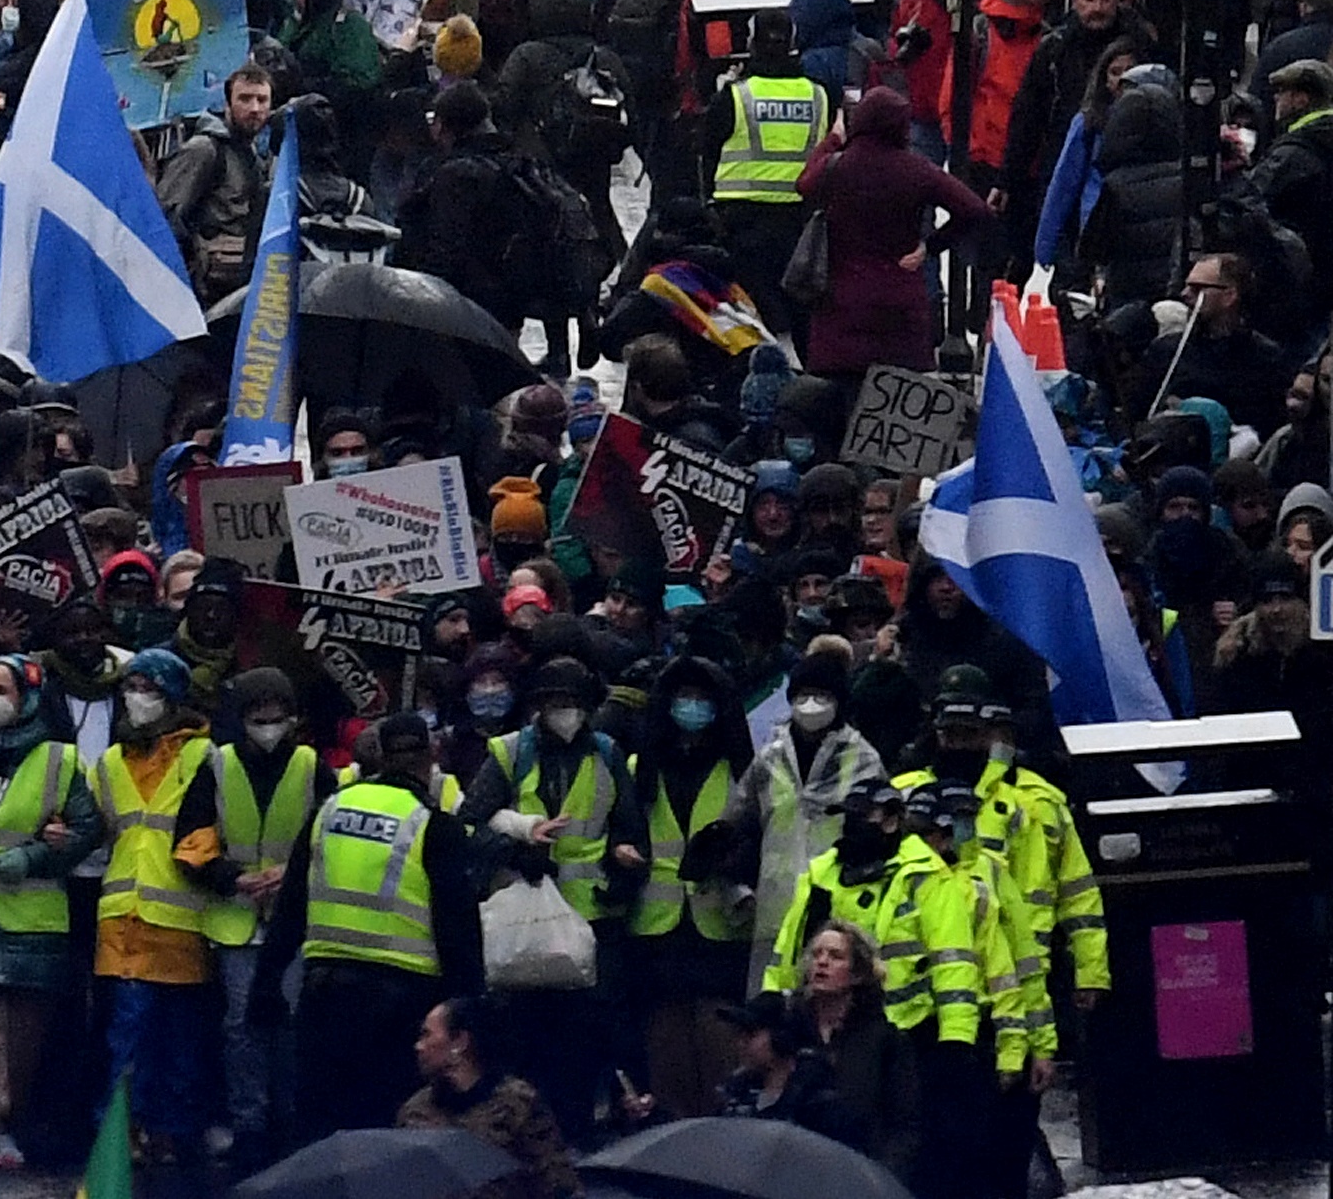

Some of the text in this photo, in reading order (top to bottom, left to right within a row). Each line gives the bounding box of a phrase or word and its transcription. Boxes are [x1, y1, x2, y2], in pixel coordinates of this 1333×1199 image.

[757, 102, 813, 121] POLICE
[863, 370, 955, 426] STOP
[639, 450, 747, 515] 4 AFRICA
[212, 501, 283, 542] FUCK
[296, 606, 423, 651] 4 AFRICA
[331, 810, 399, 839] POLICE
